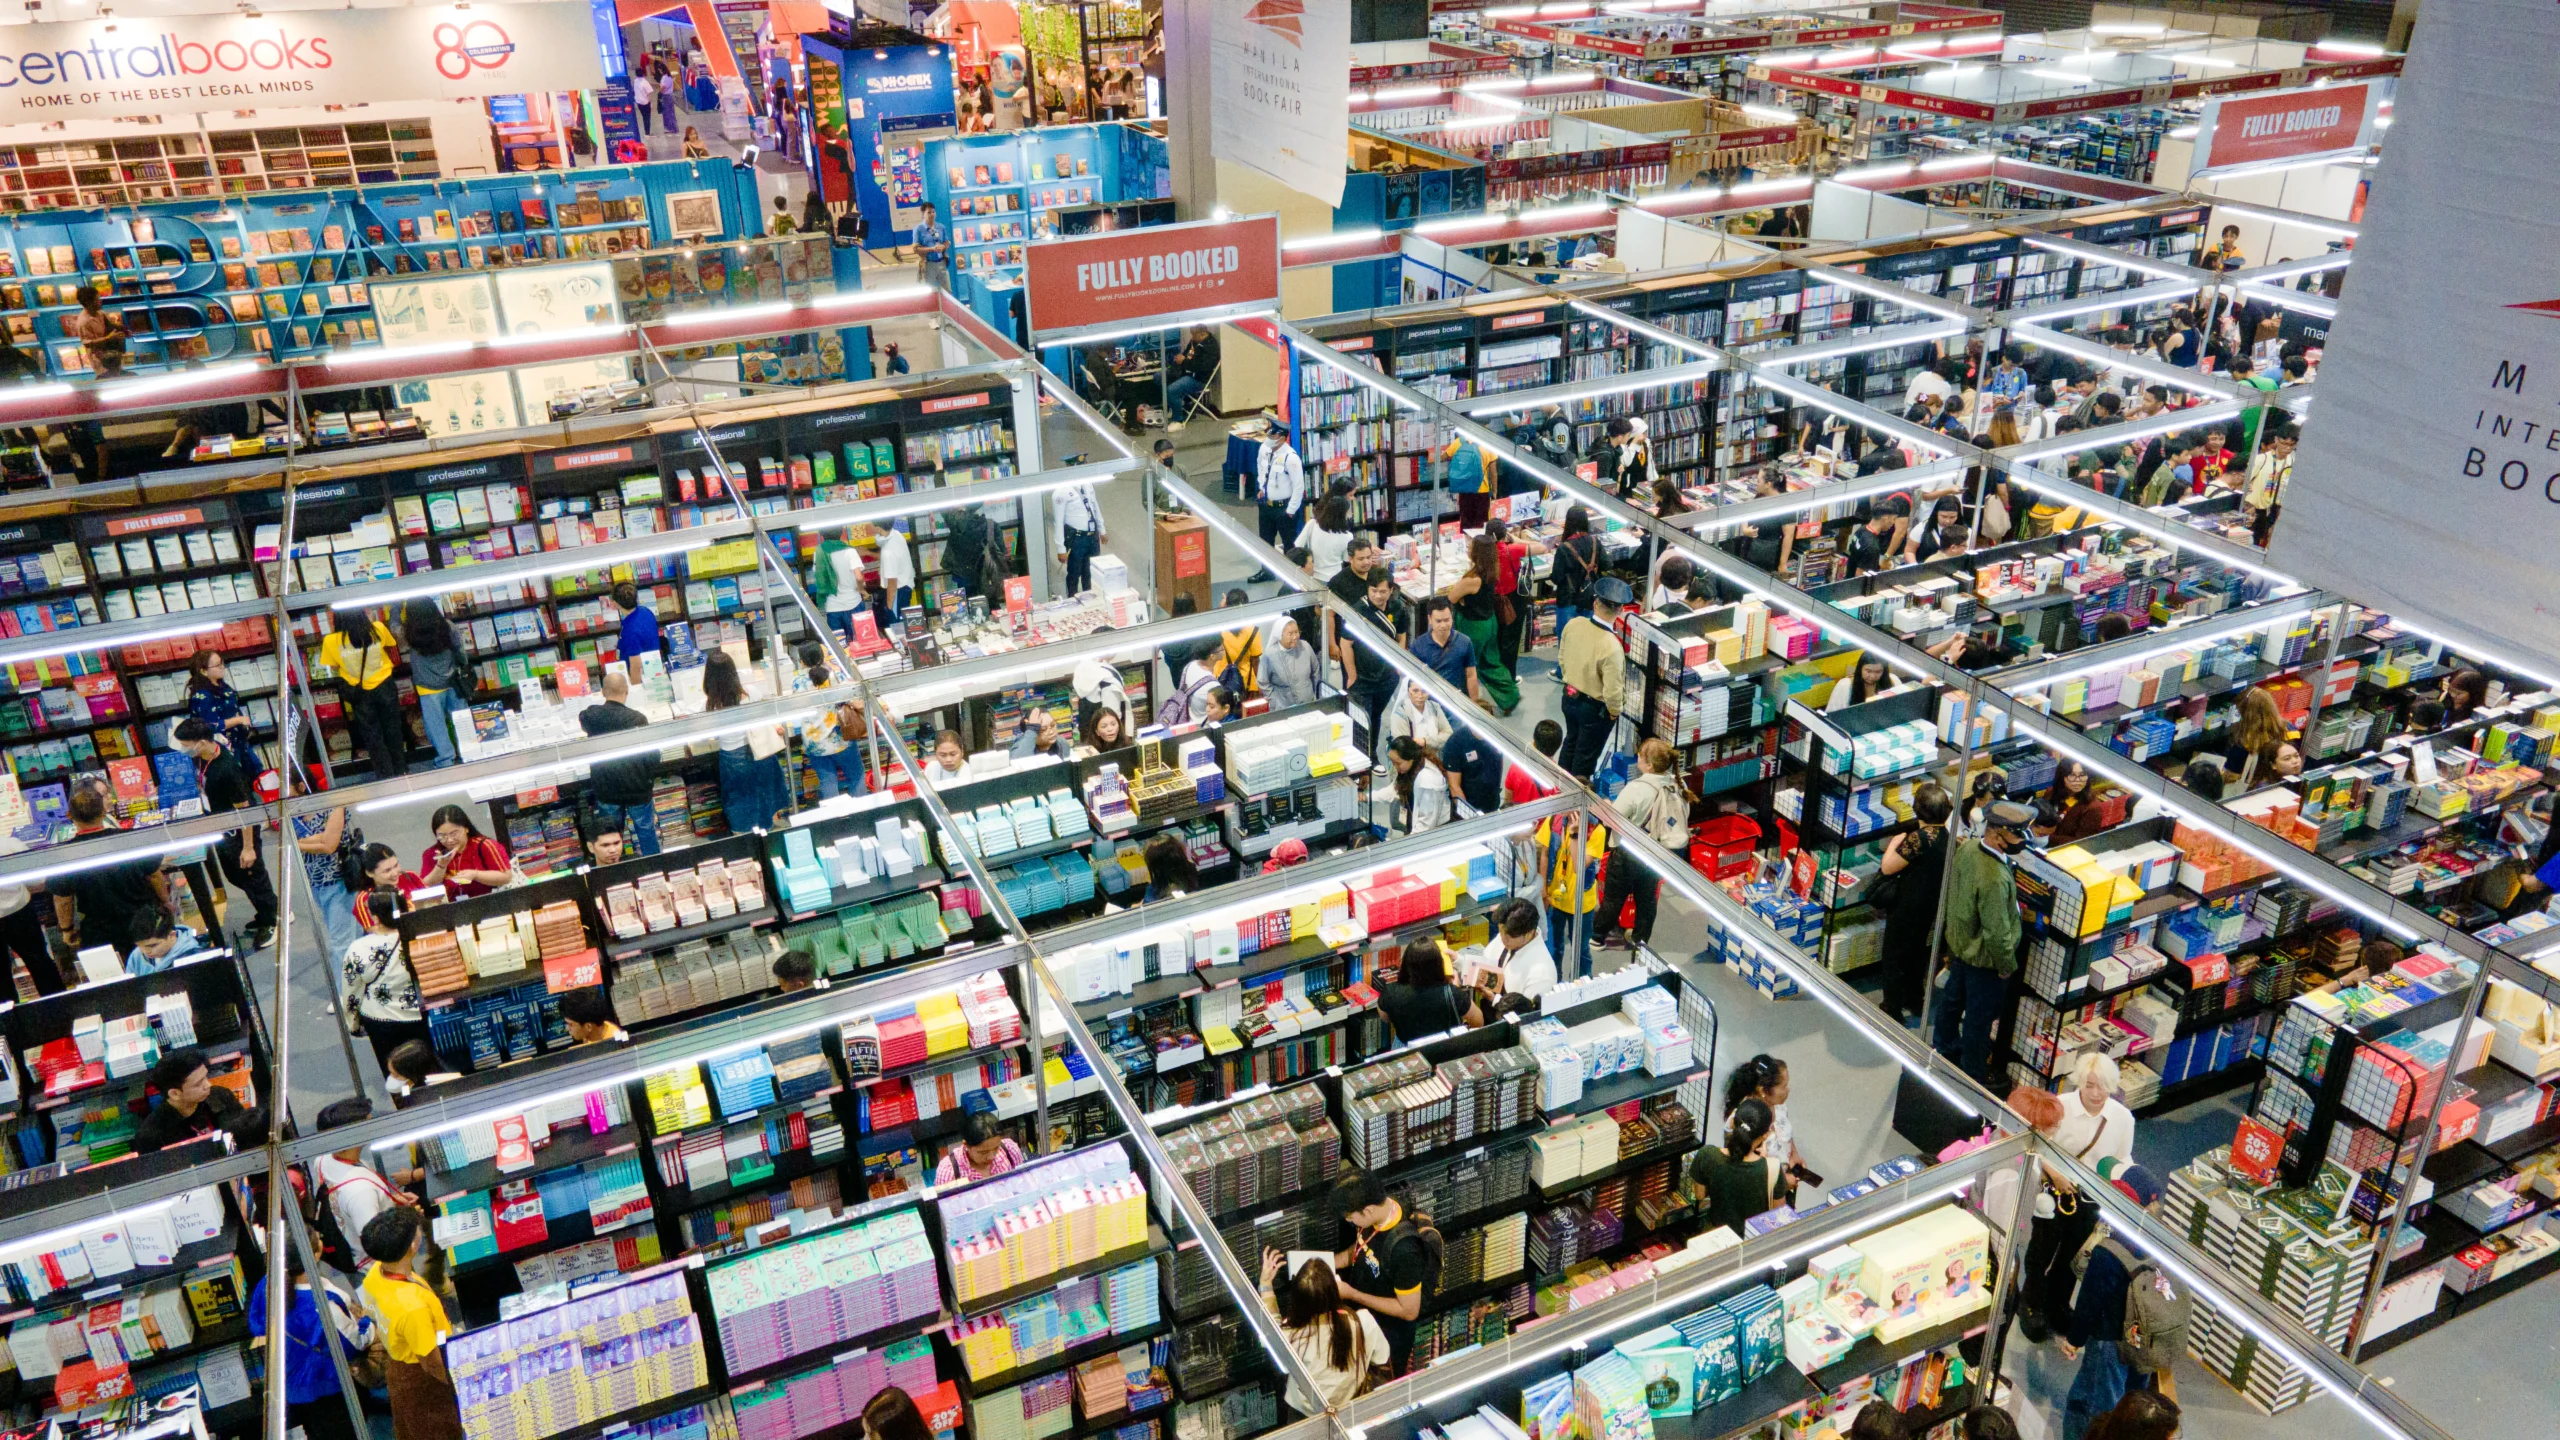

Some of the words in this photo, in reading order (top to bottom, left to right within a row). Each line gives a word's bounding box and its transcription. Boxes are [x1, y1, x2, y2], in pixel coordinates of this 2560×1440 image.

[21, 94, 74, 108] HOME
[80, 92, 102, 105] OF
[110, 90, 145, 103] THE
[149, 86, 193, 100] BEST
[199, 83, 254, 97] LEGAL
[260, 80, 315, 94] MINDS
[1274, 98, 1302, 117] FAIR
[2241, 113, 2285, 138] FULLY
[2284, 106, 2341, 132] BOOKED
[2122, 223, 2136, 232] novel
[1918, 257, 1933, 266] novel
[1077, 256, 1144, 292] FULLY
[1149, 246, 1239, 283] BOOKED
[1095, 283, 1196, 302] WWW.FULLYBOOKEDONLINE.COM
[1611, 301, 1631, 309] books
[1408, 328, 1441, 340] japanese
[1441, 324, 1463, 335] books
[816, 411, 867, 427] professional
[1557, 434, 1566, 443] 90
[568, 456, 589, 465] FULLY
[590, 451, 619, 463] BOOKED
[428, 465, 487, 483] professional
[124, 520, 149, 531] FULLY
[150, 514, 187, 527] BOOKED
[1012, 592, 1026, 600] OFF
[562, 670, 581, 679] 20%
[565, 676, 580, 685] OFF
[119, 769, 143, 779] 20%
[123, 777, 142, 786] OFF
[1270, 915, 1291, 925] NEW
[1270, 923, 1291, 933] MAP
[573, 964, 597, 976] 20%
[576, 973, 594, 984] OFF
[849, 1045, 877, 1056] FIFTH
[2245, 1132, 2271, 1156] 20%
[2245, 1144, 2267, 1164] OFF
[1959, 1238, 1984, 1250] Rachel
[1906, 1262, 1932, 1274] Rachel
[598, 1270, 619, 1281] TRUMP
[97, 1378, 126, 1392] 20%
[100, 1386, 122, 1399] OFF
[1651, 1389, 1669, 1397] LITTLE
[930, 1409, 958, 1424] 20%
[1614, 1411, 1622, 1428] 5
[934, 1417, 955, 1430] OFF
